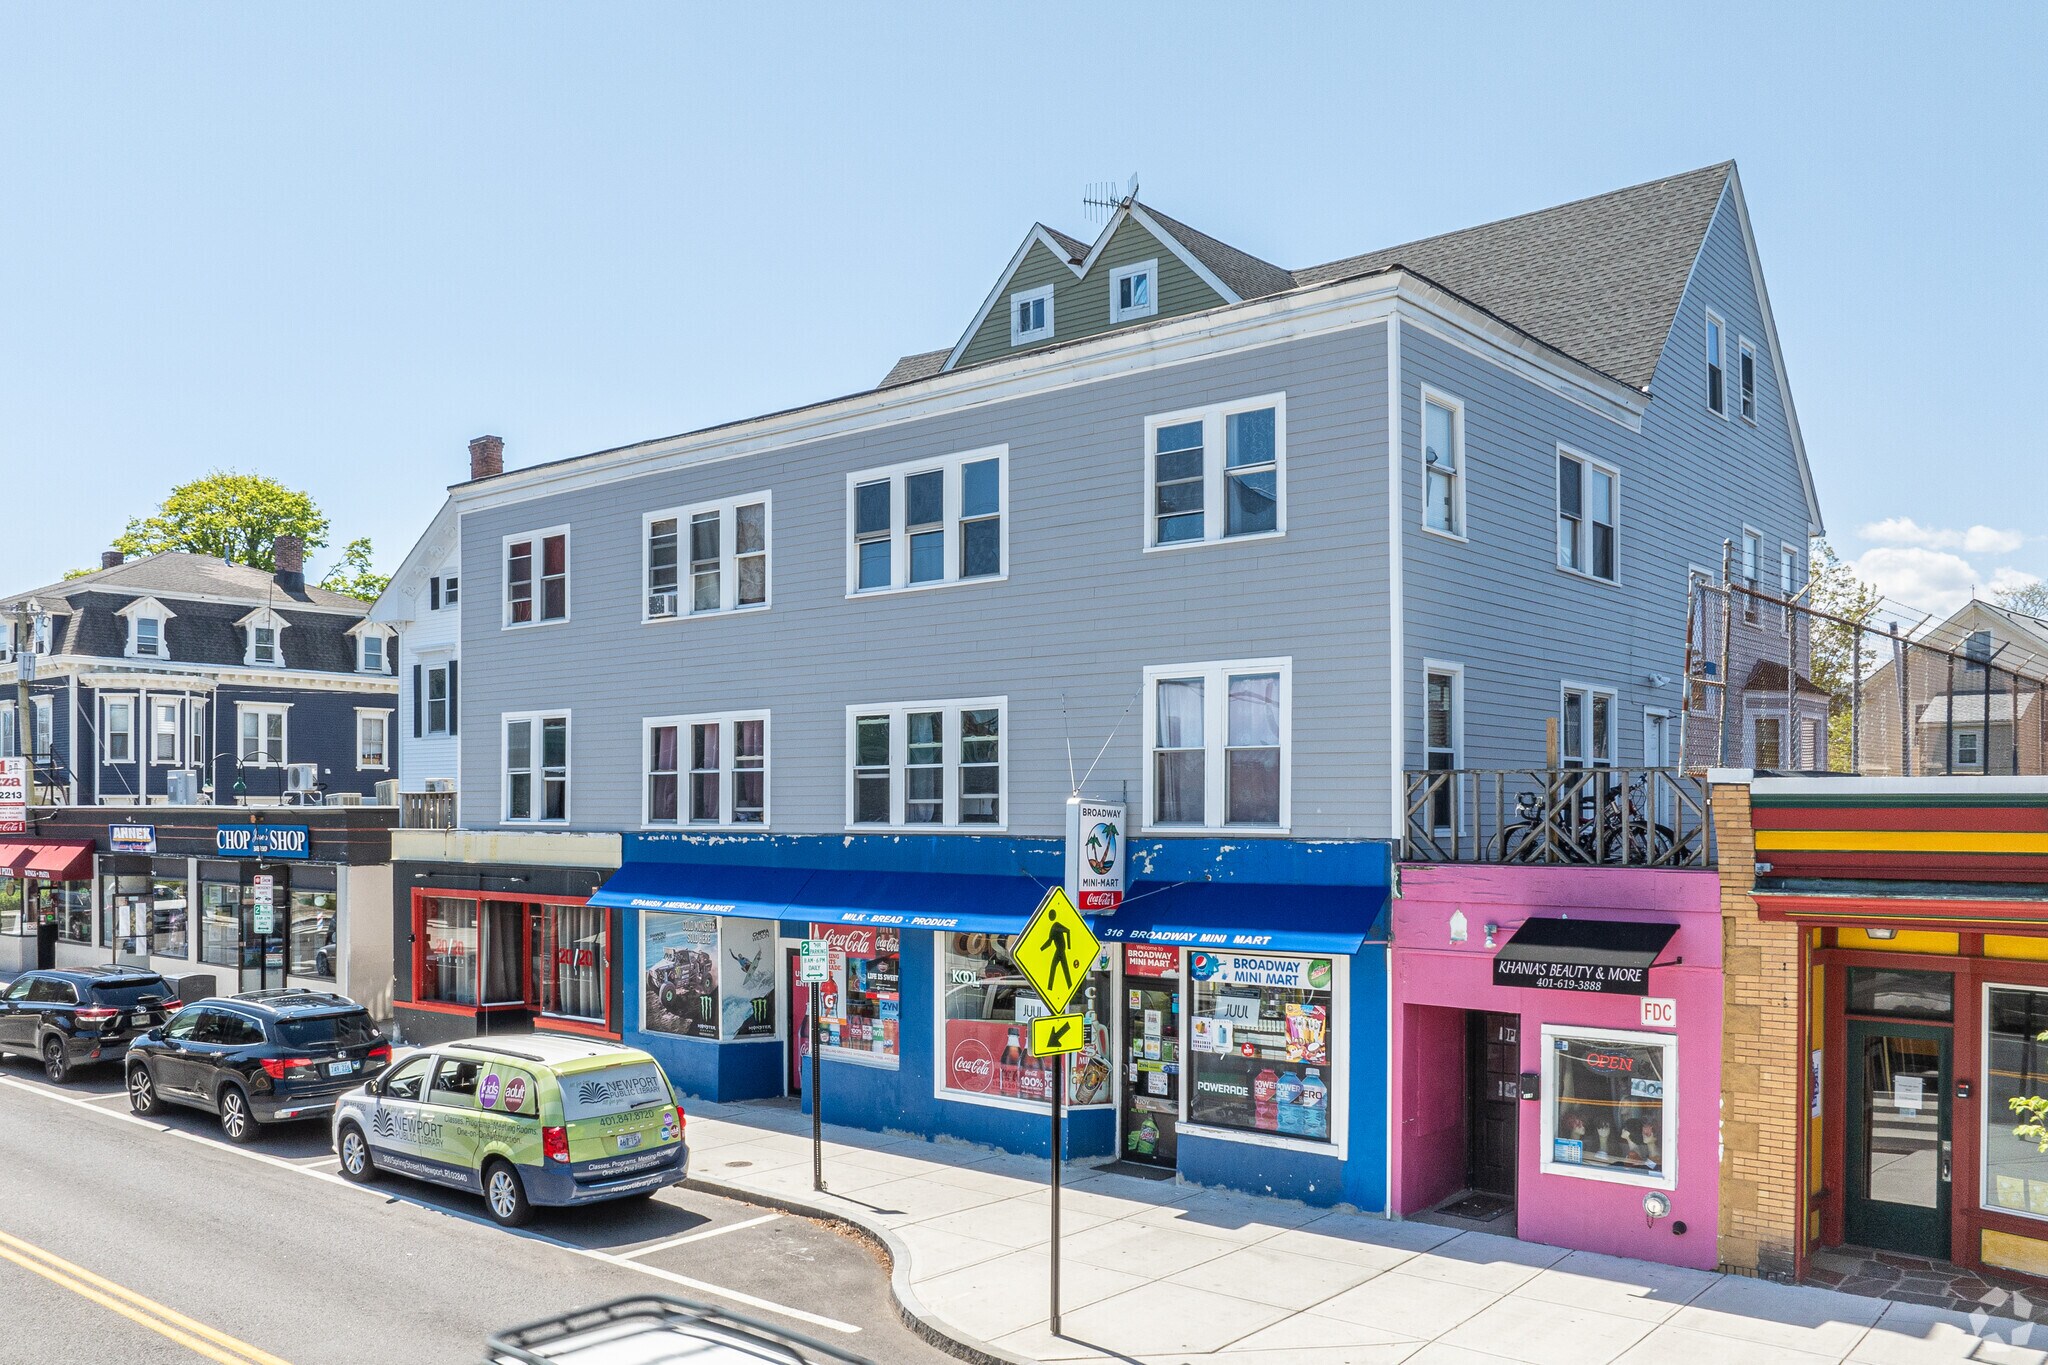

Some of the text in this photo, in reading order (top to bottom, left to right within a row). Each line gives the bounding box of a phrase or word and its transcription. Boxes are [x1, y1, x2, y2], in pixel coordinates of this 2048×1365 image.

[1083, 808, 1121, 818] BROADWAY
[112, 827, 152, 841] ANNEX
[216, 829, 250, 849] CHOP
[270, 829, 306, 851] SHOP
[1083, 879, 1119, 887] MINI-MART
[630, 899, 736, 912] SPANISH AMERICAN MARKET
[1086, 892, 1112, 906] Coca-Cola
[841, 912, 959, 927] MILK BREAD PRODUCE
[824, 930, 877, 953] Coca-Cola
[1104, 928, 1272, 945] 316 BROADWAY MINI MART
[802, 943, 809, 954] 2
[1128, 949, 1173, 960] BROADWAY
[559, 948, 594, 970] 20/20
[1129, 957, 1171, 968] MINI MART
[1233, 958, 1301, 974] BROADWAY
[951, 969, 981, 988] KOOL
[1235, 970, 1263, 983] MINI
[1266, 972, 1299, 986] MART
[1498, 960, 1643, 983] KHANIA'S BEAUTY & MORE
[1536, 977, 1602, 991] 401-619-3888
[1644, 1003, 1673, 1022] FDC
[954, 1056, 991, 1075] Coca-Cola
[1587, 1053, 1634, 1072] OPEN
[481, 1082, 499, 1095] kids
[605, 1076, 657, 1093] NEWPORT
[1020, 1076, 1044, 1088] 100%
[1197, 1081, 1249, 1097] POWERADE
[505, 1085, 525, 1099] adult
[609, 1084, 661, 1099] PUBLIC LIBRARY
[1303, 1090, 1323, 1100] ERO
[600, 1110, 655, 1127] 401.847.8720
[395, 1115, 443, 1139] NEWPORT
[395, 1131, 444, 1149] PUBLIC LIBRARY
[589, 1161, 611, 1171] Classes.
[612, 1158, 637, 1169] Programs.
[637, 1154, 657, 1164] Meeting
[602, 1161, 660, 1177] One-on-One Instruction.
